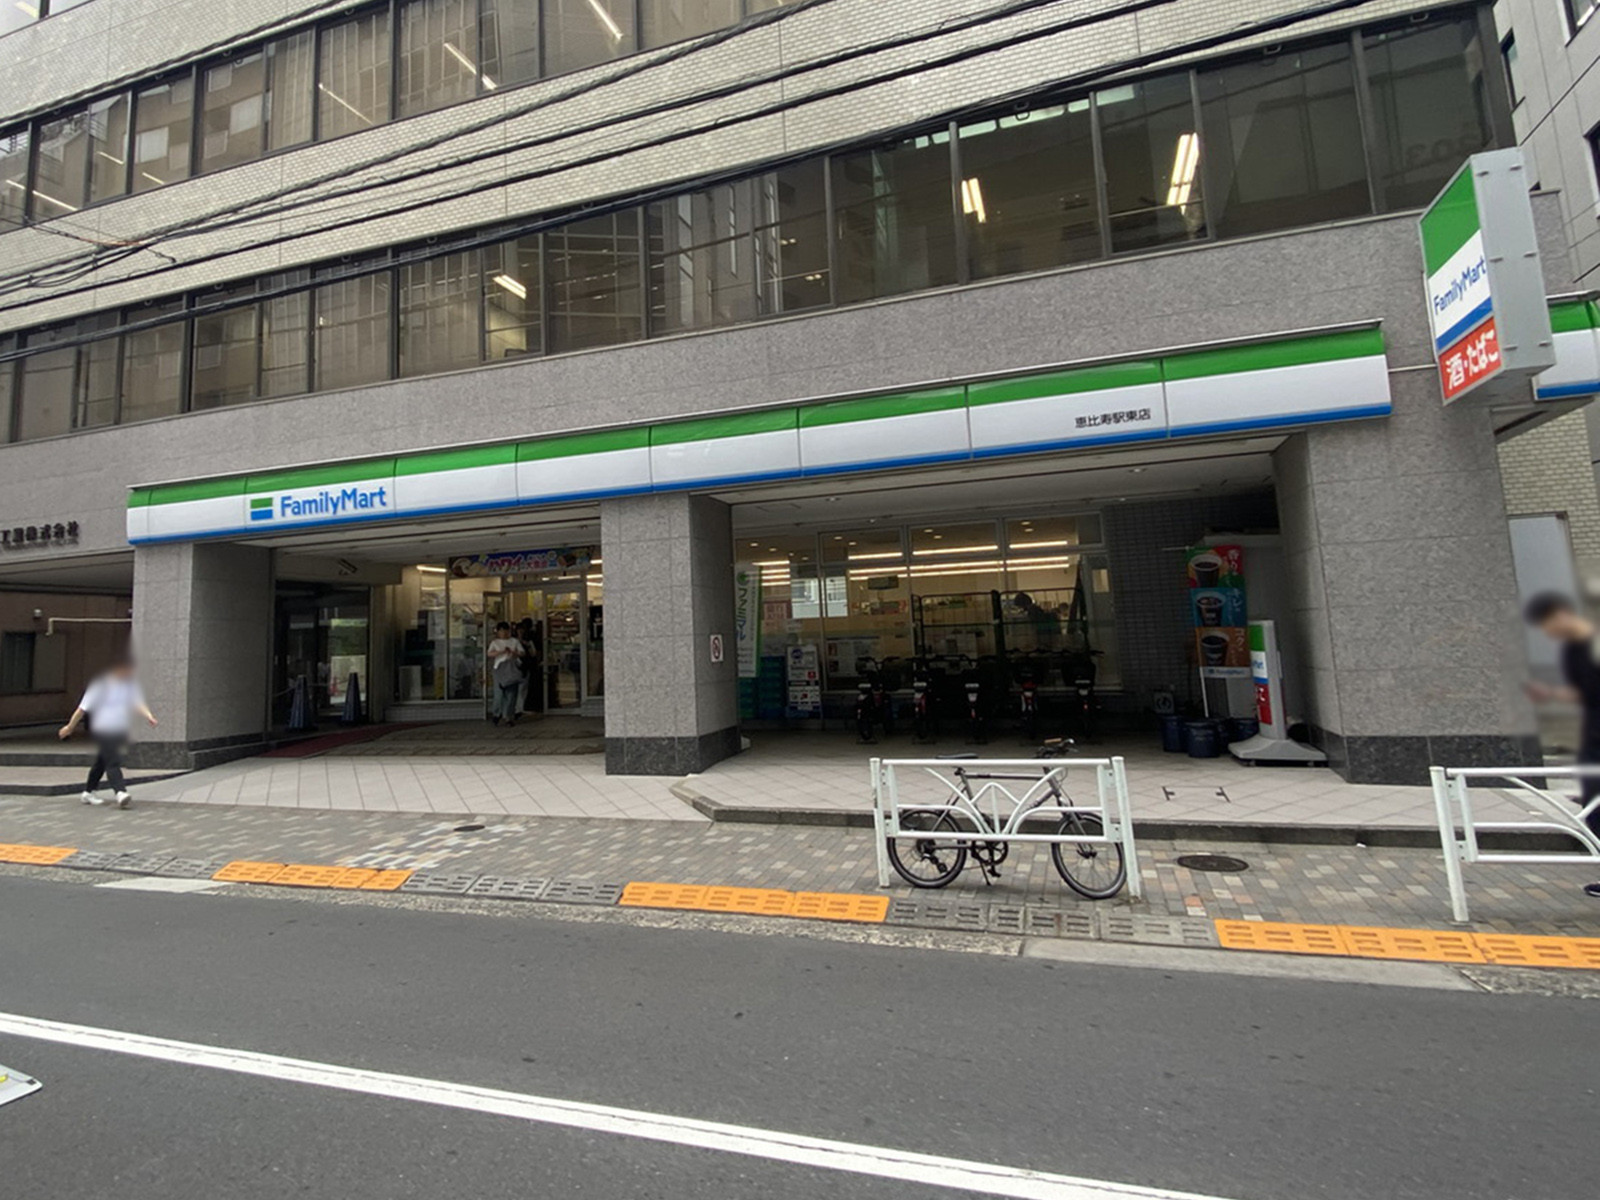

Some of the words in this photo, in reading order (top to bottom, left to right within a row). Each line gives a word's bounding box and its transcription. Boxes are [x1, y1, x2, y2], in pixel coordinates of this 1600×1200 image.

[1434, 258, 1487, 316] FamilyMart
[1445, 329, 1498, 389] 酒・たばこ
[1075, 408, 1151, 428] 恵比寿駅東店
[281, 486, 387, 517] FamilyMart
